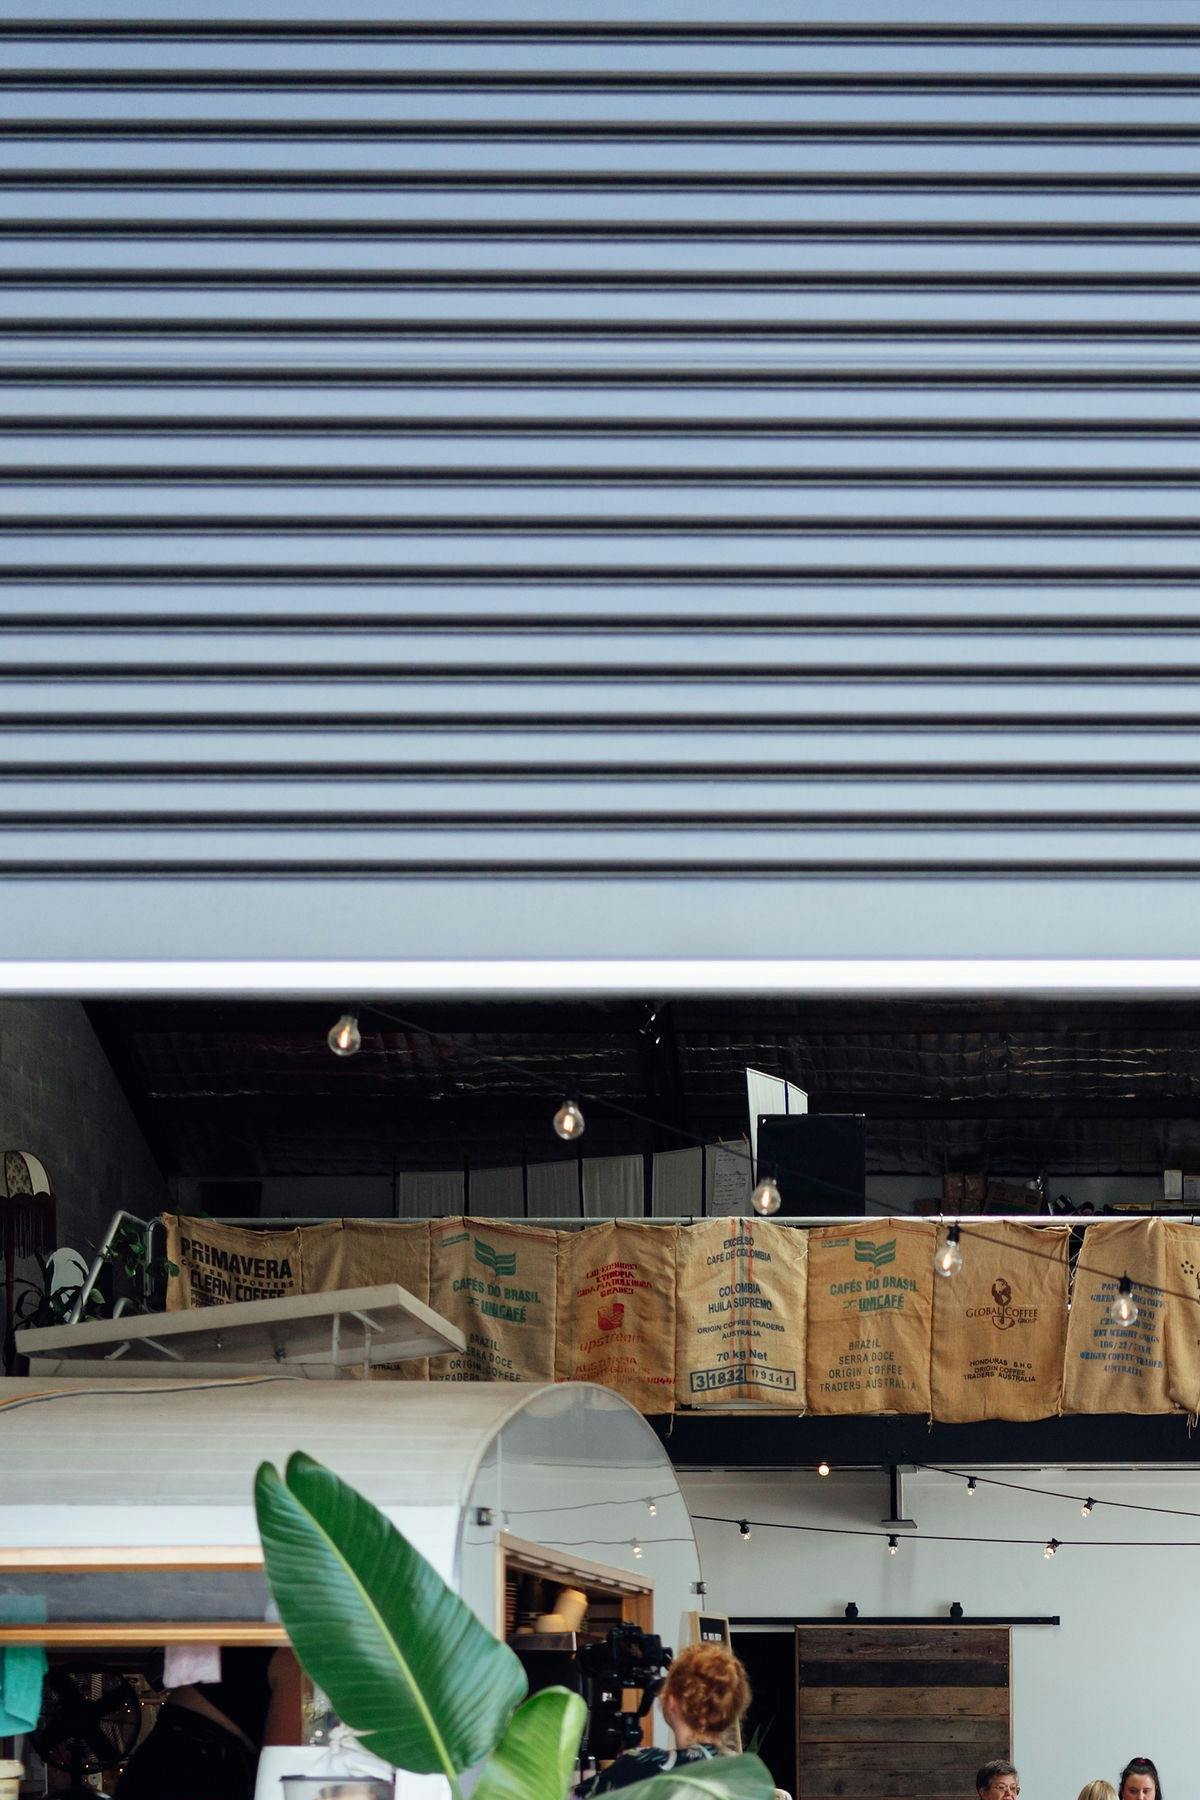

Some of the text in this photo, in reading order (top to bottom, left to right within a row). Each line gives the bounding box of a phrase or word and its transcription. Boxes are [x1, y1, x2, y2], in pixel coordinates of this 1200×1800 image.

[723, 1236, 754, 1249] EXCELSO
[181, 1237, 292, 1279] PRIMAVERA
[726, 1250, 735, 1260] DE
[736, 1248, 771, 1262] COLOMBIA
[719, 1283, 761, 1297] COLOMBIA
[830, 1275, 918, 1295] CAFÉS DO BRASIL
[504, 1287, 541, 1303] BRASIL
[708, 1297, 772, 1313] HUILA SUPREMO
[965, 1306, 1038, 1319] GLOBAL COFFEE
[697, 1320, 785, 1335] ORIGIN COFFEE TRADERS
[722, 1330, 761, 1340] AUSTRALIA
[848, 1337, 880, 1350] BRAZIL
[716, 1350, 768, 1362] 70 kg Net
[838, 1352, 894, 1365] SERRA DOCE
[969, 1357, 1008, 1367] HONDURAS
[450, 1360, 482, 1372] ORIGIN
[828, 1365, 902, 1378] ORIGIN COFFEE
[974, 1365, 1025, 1376] ORIGIN COFFEE
[963, 1371, 1036, 1382] TRADERS AUSTRALIA
[820, 1380, 917, 1392] TRADERS AUSTRALIA
